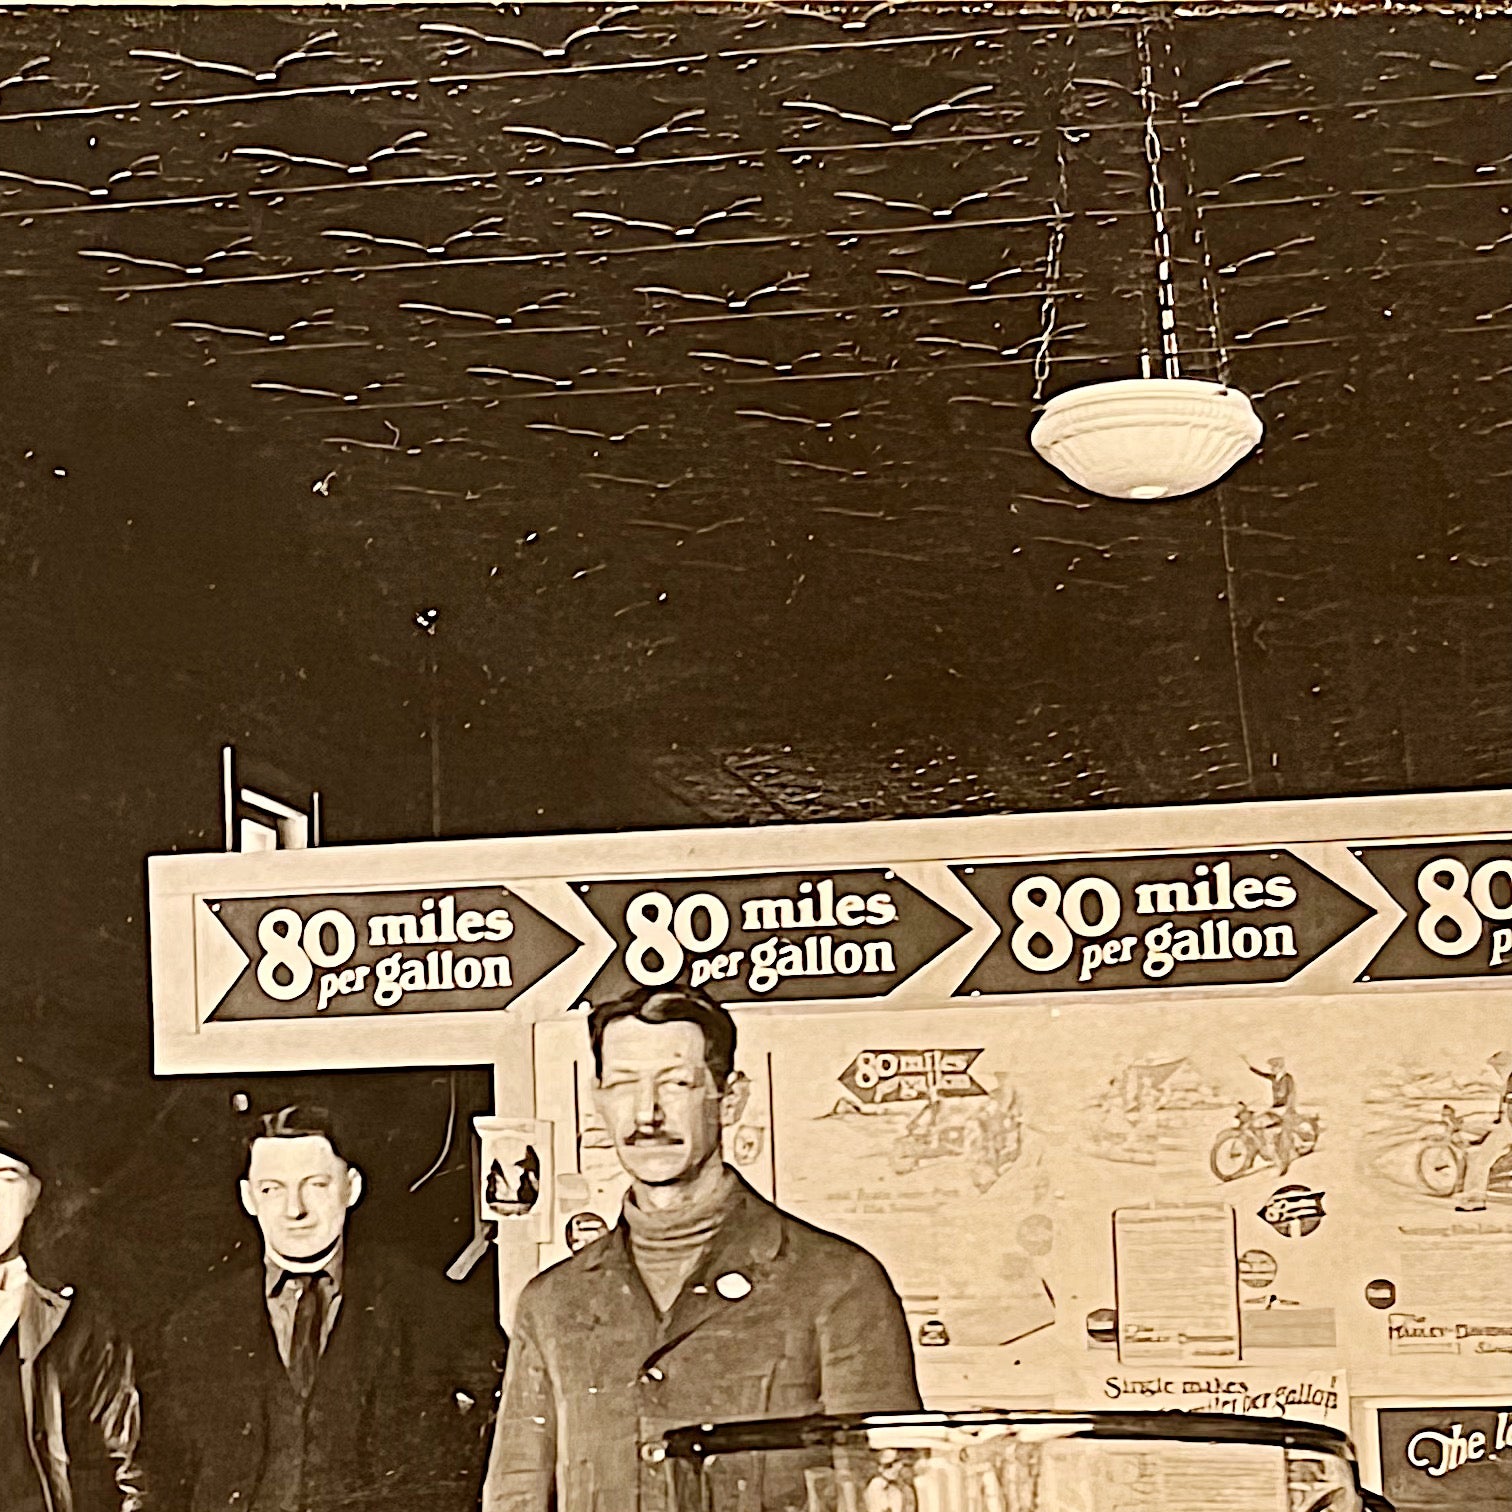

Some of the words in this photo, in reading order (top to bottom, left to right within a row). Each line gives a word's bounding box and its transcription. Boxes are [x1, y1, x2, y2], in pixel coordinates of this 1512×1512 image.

[624, 891, 730, 987] 80
[741, 878, 897, 931] miles
[1010, 874, 1122, 972] 80
[1134, 861, 1298, 915] miles
[1416, 857, 1512, 956] 80
[255, 907, 356, 1001] 80
[367, 896, 515, 946] miles
[316, 966, 371, 1011] per
[372, 948, 513, 1008] gallon
[690, 950, 745, 988] per
[748, 935, 896, 993] gallon
[1078, 934, 1138, 982] per
[1143, 917, 1298, 979] gallon
[855, 1052, 899, 1088] 80
[1104, 1376, 1175, 1399] Single
[1407, 1423, 1486, 1477] The
